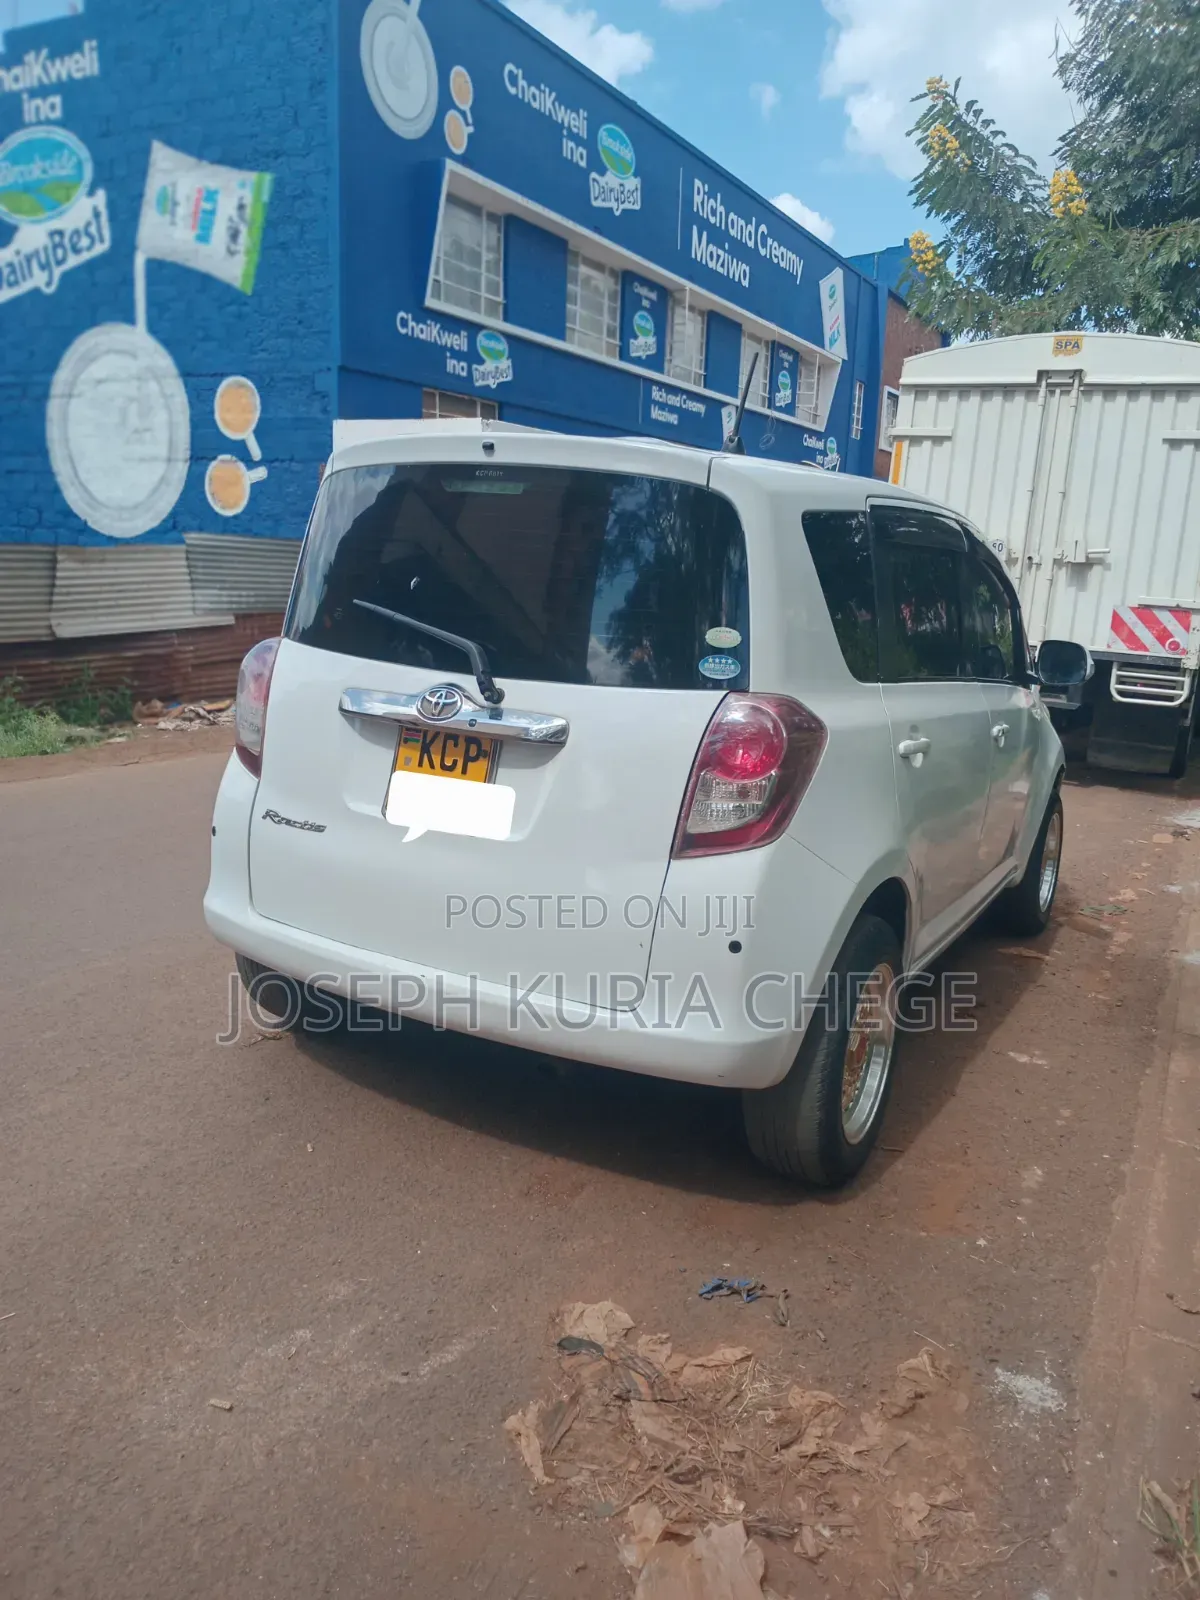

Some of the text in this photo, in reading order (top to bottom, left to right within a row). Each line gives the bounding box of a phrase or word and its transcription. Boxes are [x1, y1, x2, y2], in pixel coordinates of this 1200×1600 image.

[22, 94, 62, 123] ina
[503, 62, 588, 140] ChaiKweli
[562, 129, 587, 168] ina
[592, 178, 639, 211] DairyBest
[693, 178, 803, 285] Rich and Creamy
[691, 225, 750, 288] Maziwa
[396, 311, 468, 352] ChaiKweli
[1056, 341, 1080, 349] SPA
[446, 352, 467, 377] ina
[651, 404, 678, 426] Maziwa
[652, 385, 706, 418] Rich and Creamy
[417, 730, 483, 776] KCP
